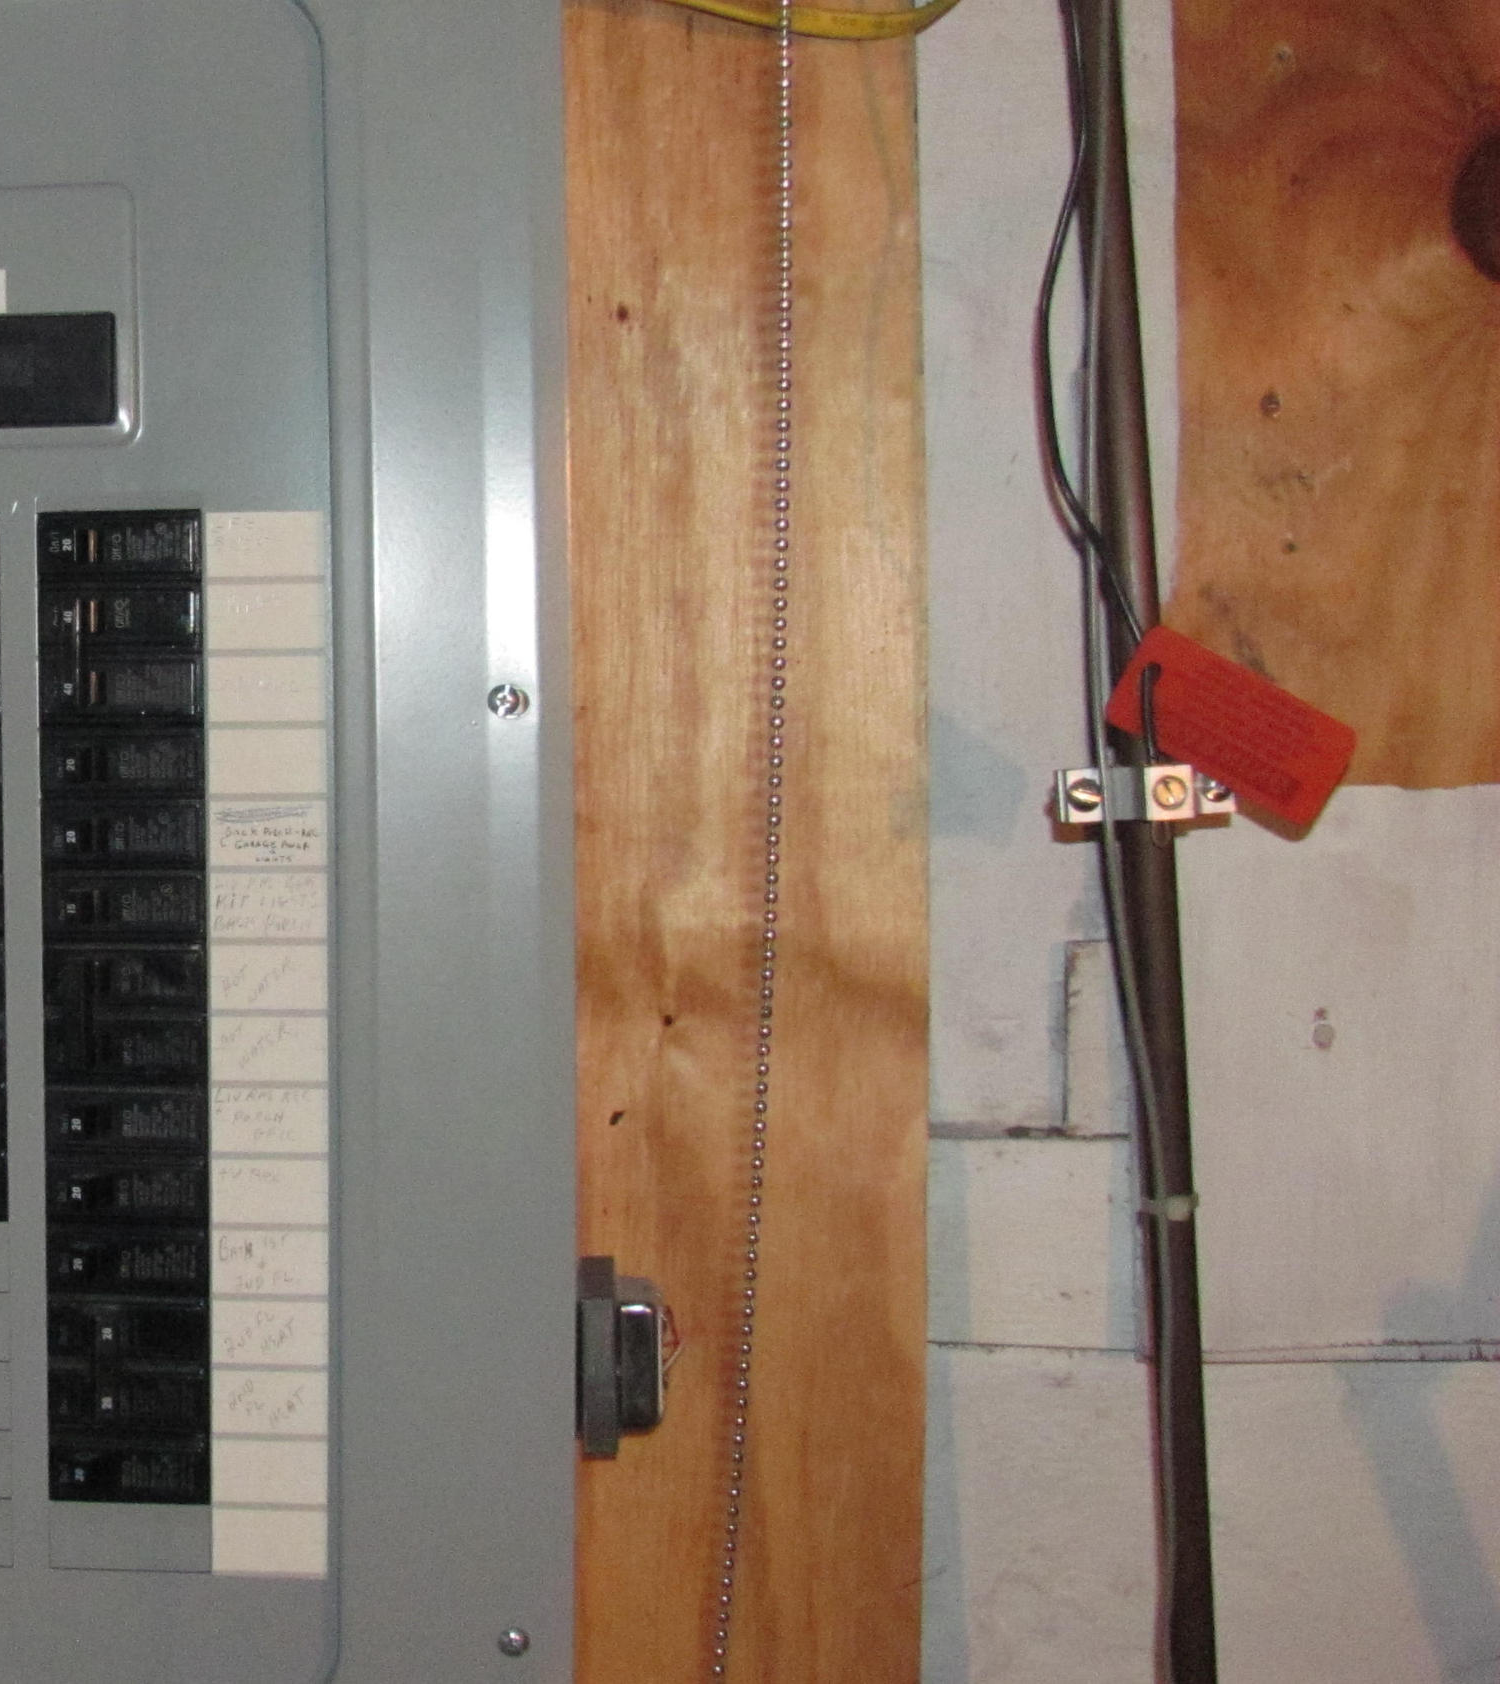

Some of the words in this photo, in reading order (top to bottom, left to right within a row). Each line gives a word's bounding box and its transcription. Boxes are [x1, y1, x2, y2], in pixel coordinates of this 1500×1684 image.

[62, 538, 72, 551] 20
[63, 610, 73, 623] 40
[63, 683, 73, 696] 40
[66, 758, 76, 771] 20
[66, 830, 76, 843] 20
[67, 903, 77, 914] 15
[71, 1117, 82, 1131] 20
[71, 1186, 82, 1200] 20
[72, 1257, 83, 1271] 20
[101, 1327, 112, 1340] 20
[101, 1396, 112, 1410] 20
